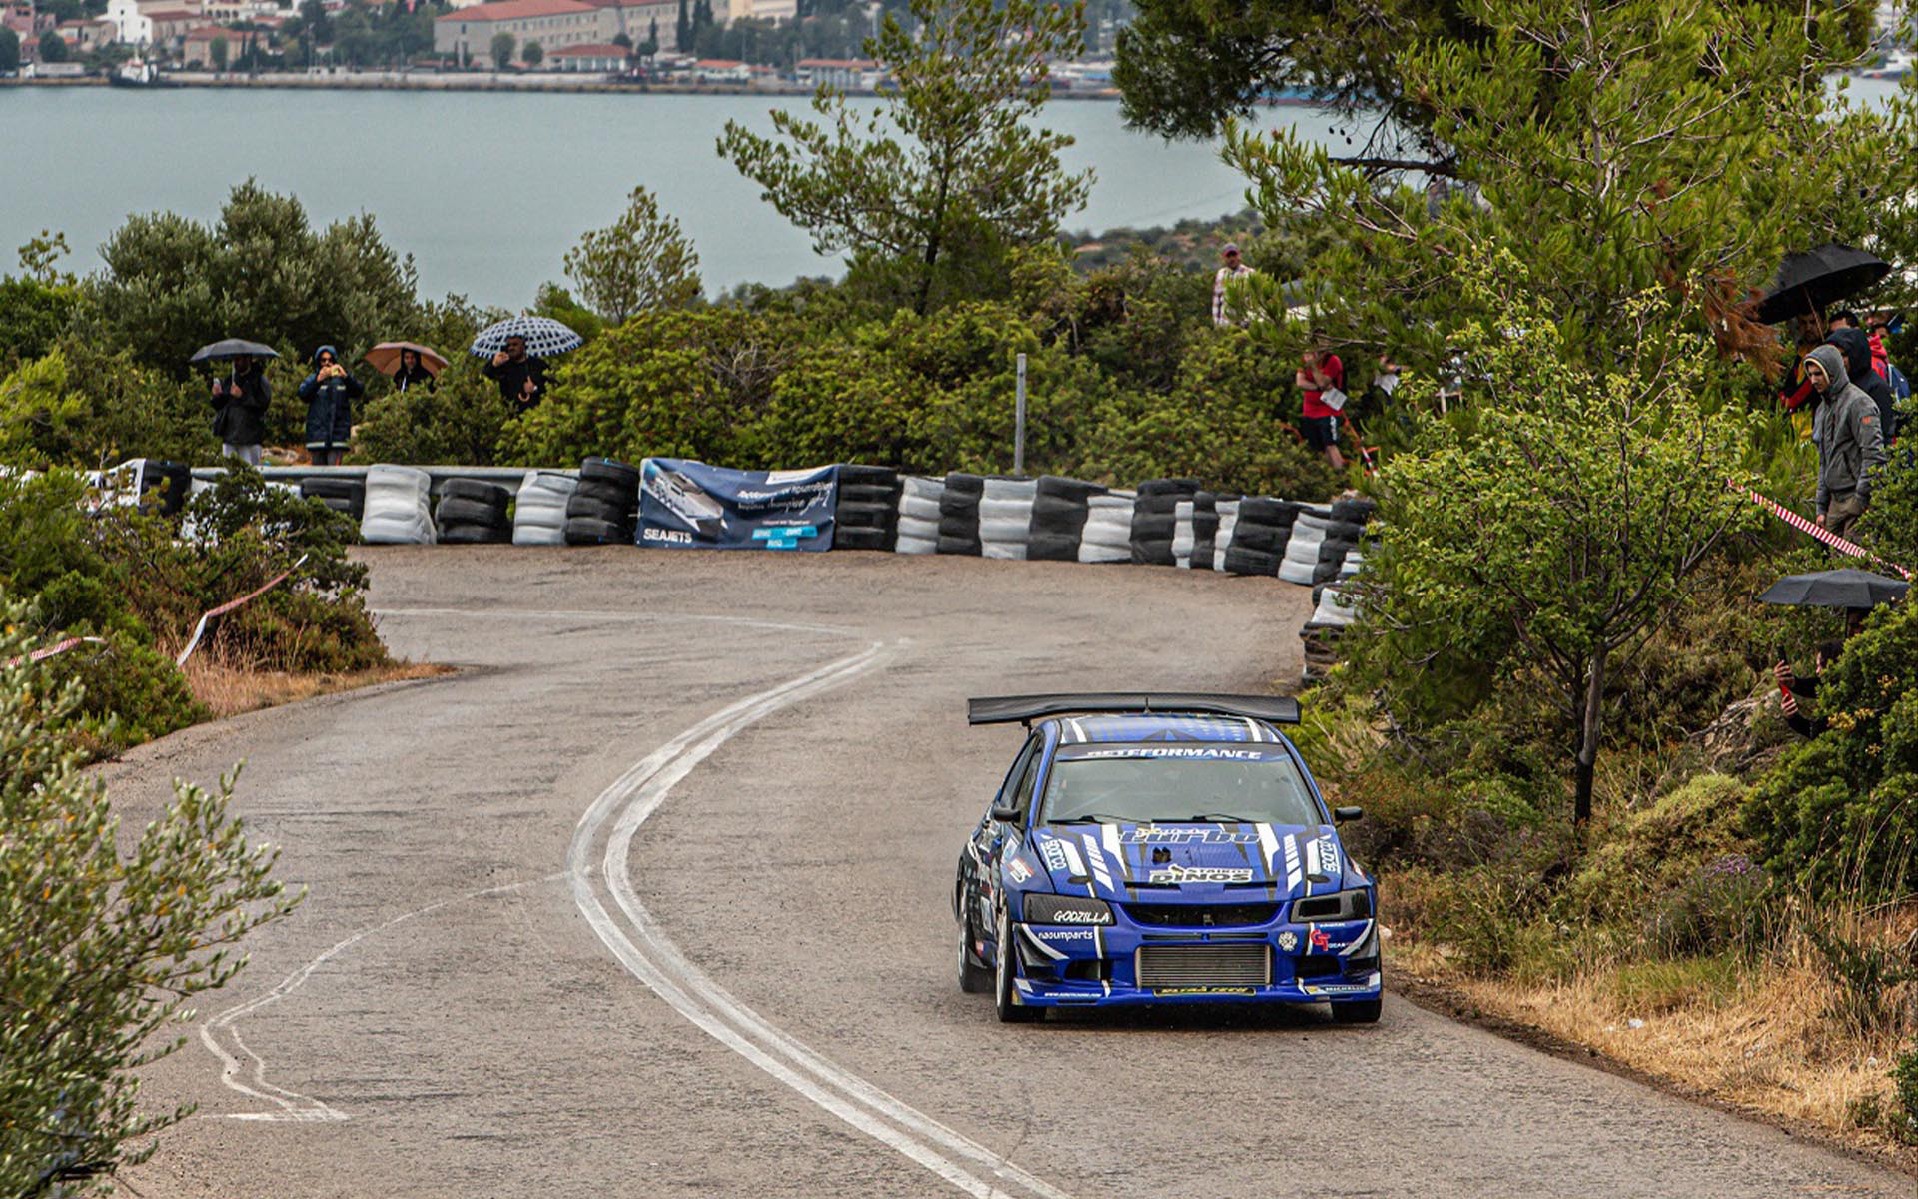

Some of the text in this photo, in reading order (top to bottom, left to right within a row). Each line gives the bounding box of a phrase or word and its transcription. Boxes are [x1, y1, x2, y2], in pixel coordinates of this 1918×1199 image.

[643, 528, 692, 543] SEAJETS
[1151, 872, 1250, 882] DINOS
[1053, 910, 1110, 923] GODZILLA
[1038, 930, 1094, 942] naoumparts
